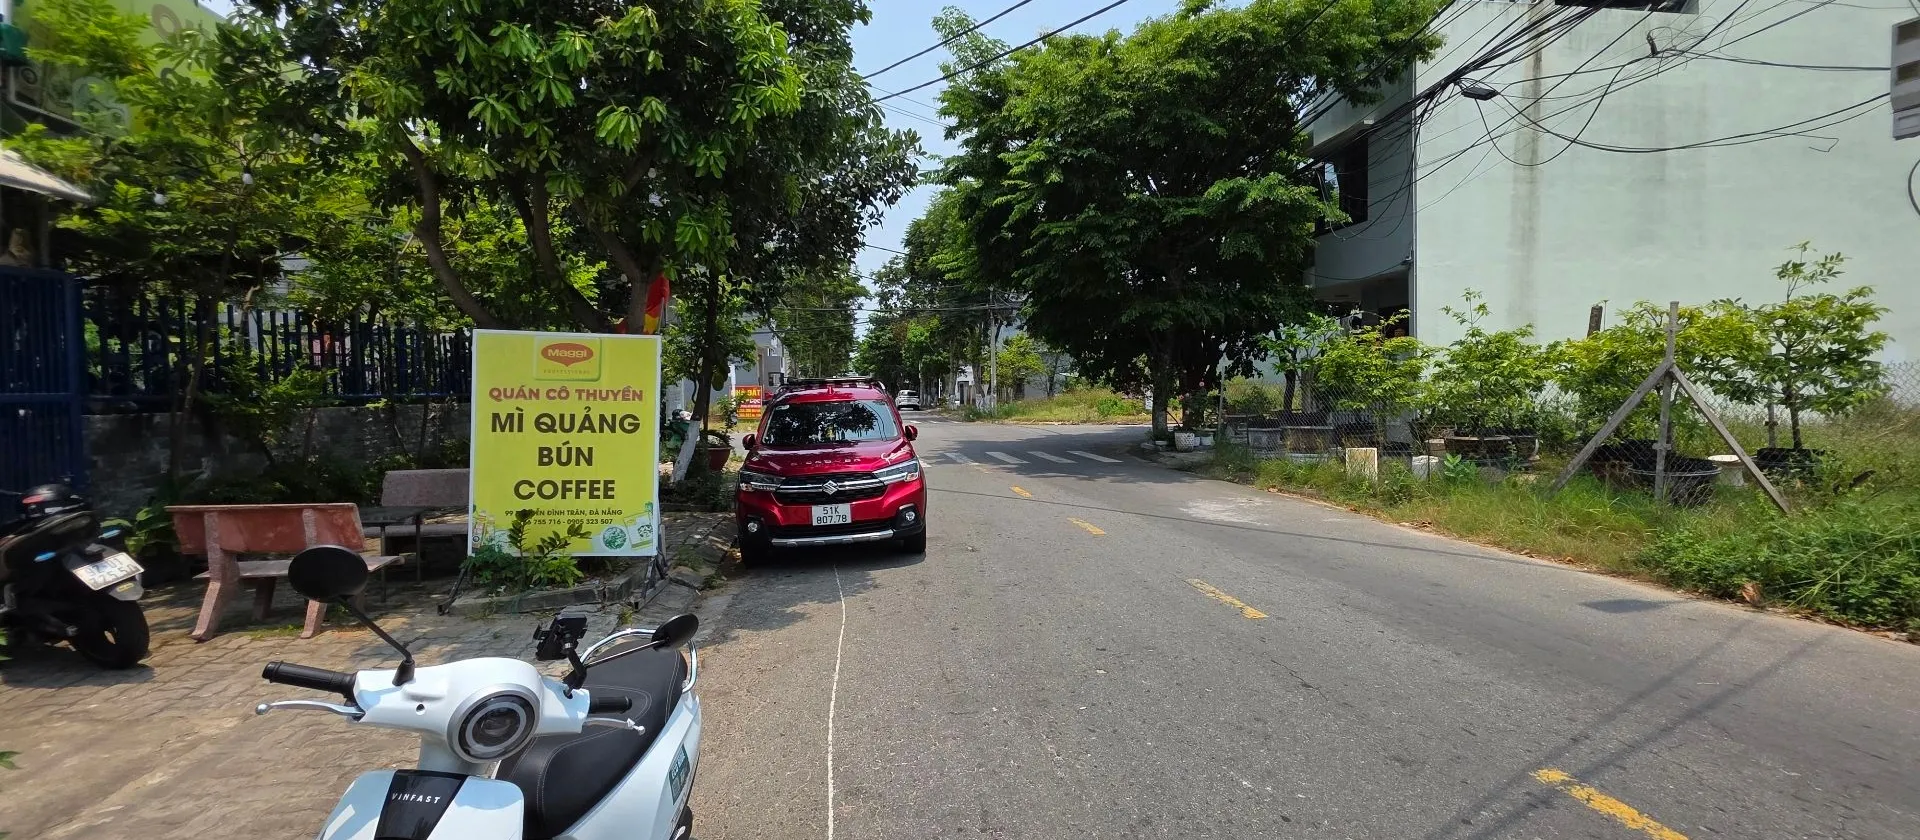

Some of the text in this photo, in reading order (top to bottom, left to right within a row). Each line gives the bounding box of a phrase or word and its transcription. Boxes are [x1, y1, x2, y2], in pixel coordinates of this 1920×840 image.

[547, 348, 587, 358] Maggi
[488, 385, 643, 402] QUÁN CÔ THUYỀN
[491, 406, 641, 434] MÌ QUẢNG
[537, 440, 594, 467] BÚN
[513, 479, 616, 501] COFFEE
[547, 508, 565, 516] ĐÌNH
[589, 508, 600, 516] ĐÀ
[822, 506, 840, 515] 51K
[816, 514, 848, 525] 807.78
[391, 792, 441, 804] VINFAST
